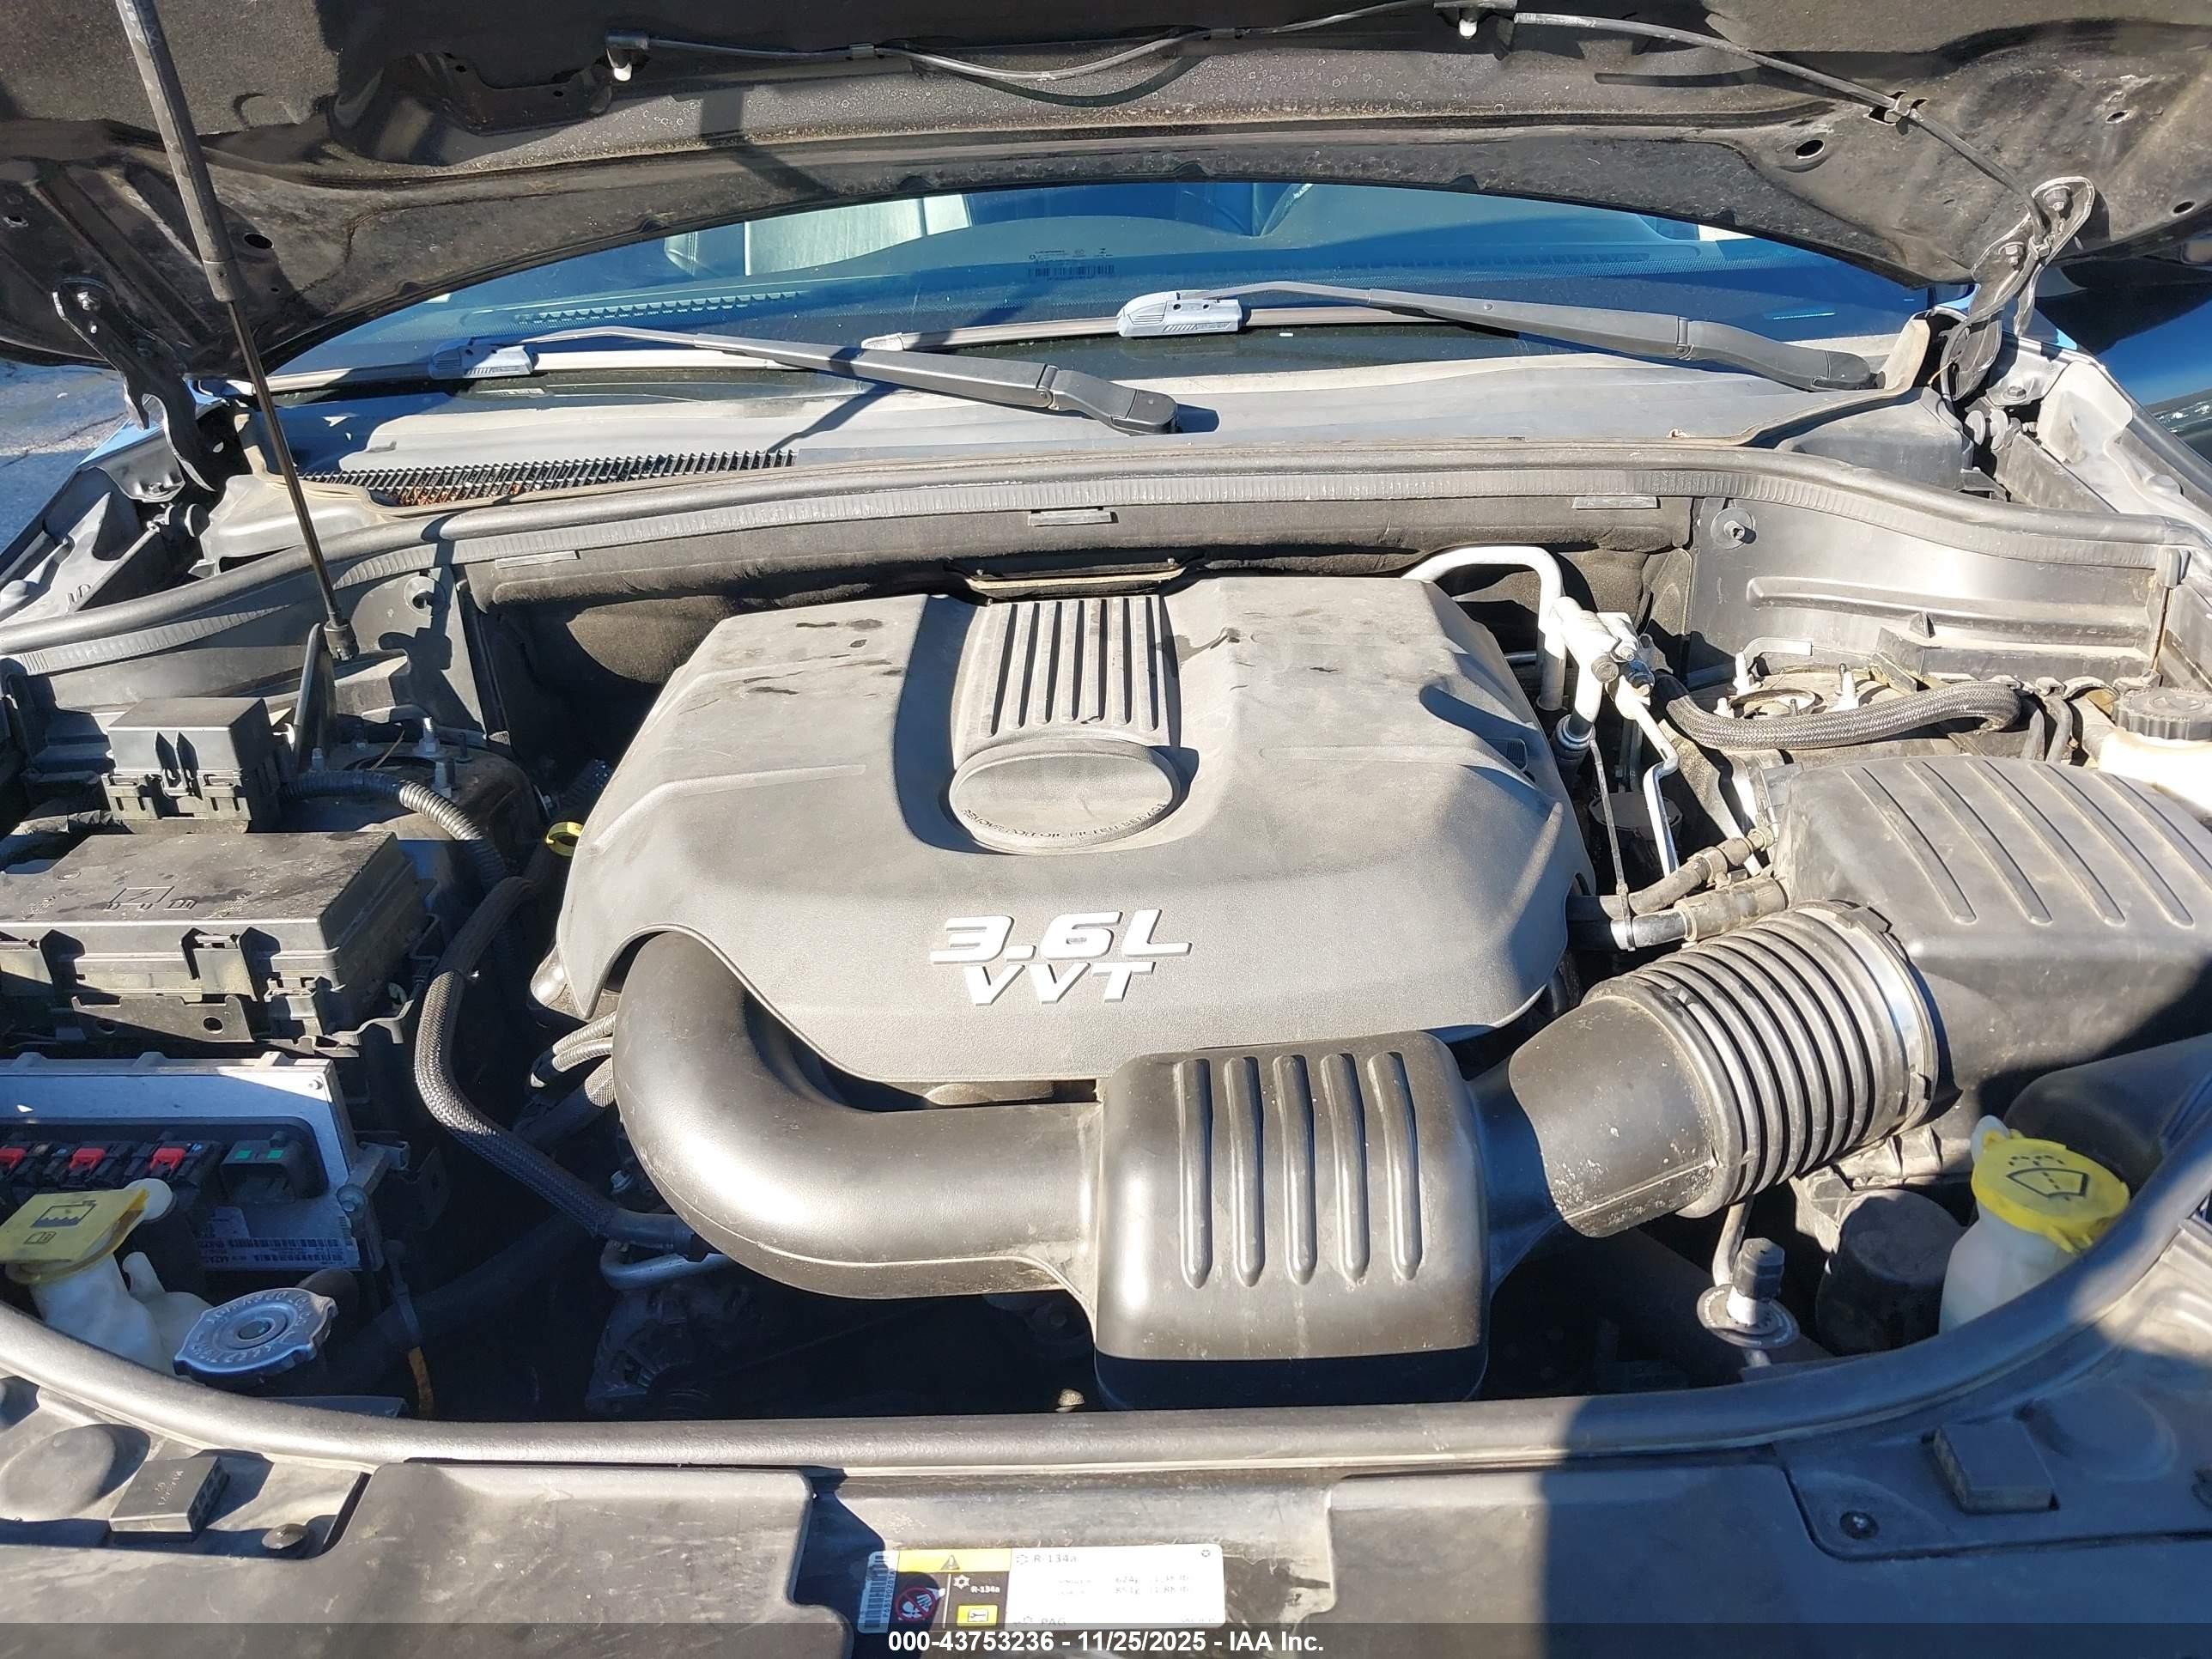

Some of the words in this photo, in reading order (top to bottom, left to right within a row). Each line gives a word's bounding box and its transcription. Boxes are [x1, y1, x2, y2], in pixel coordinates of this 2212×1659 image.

[929, 908, 1193, 964] 3.6L
[963, 961, 1157, 1006] VVT
[1033, 1553, 1078, 1564] R-134a
